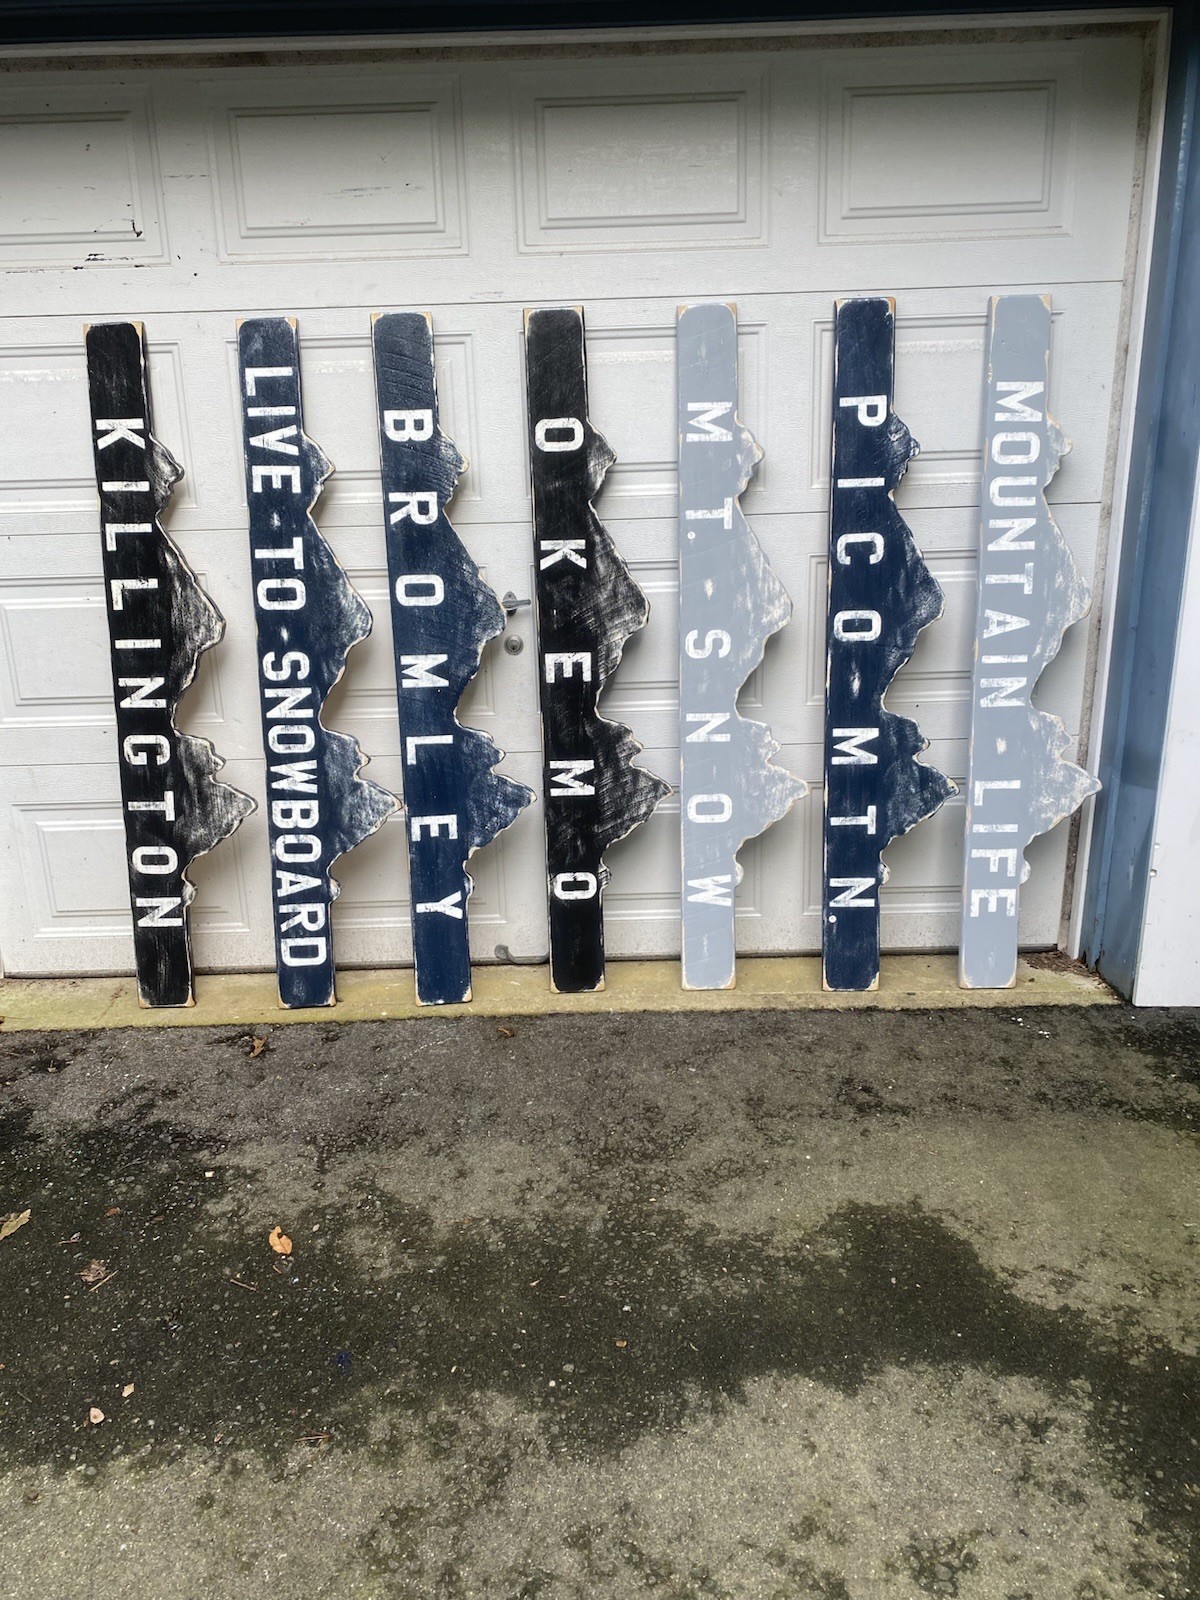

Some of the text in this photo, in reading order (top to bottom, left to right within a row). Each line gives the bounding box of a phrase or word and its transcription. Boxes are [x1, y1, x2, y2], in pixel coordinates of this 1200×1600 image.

[96, 418, 184, 928] KILLINGTON
[245, 367, 327, 967] LIVE TO SNOWBOARD
[384, 409, 463, 920] BROMLEY
[535, 417, 598, 900] OKEMO
[685, 401, 733, 907] MT. SNOW
[828, 394, 888, 923] PICO MTN.
[970, 381, 1044, 918] MOUNTAIN LIFE
